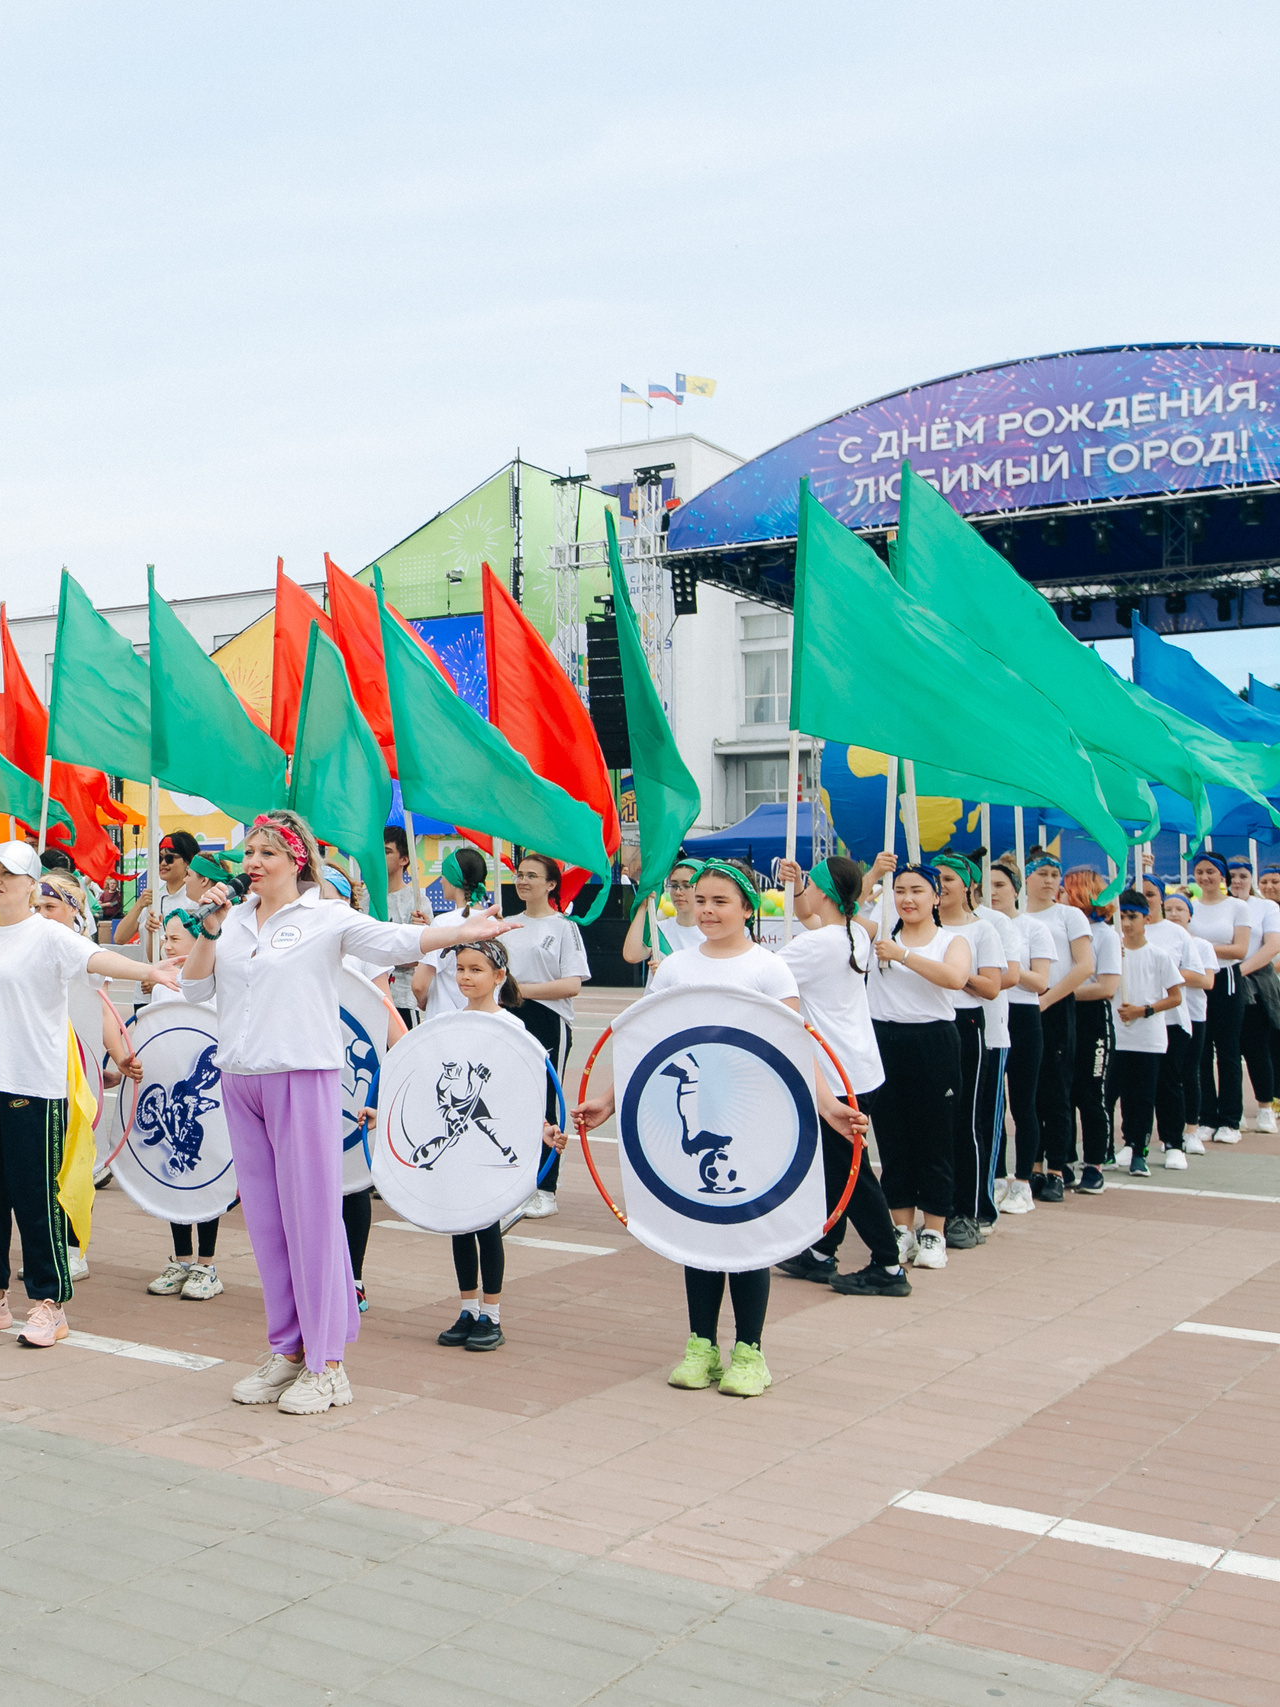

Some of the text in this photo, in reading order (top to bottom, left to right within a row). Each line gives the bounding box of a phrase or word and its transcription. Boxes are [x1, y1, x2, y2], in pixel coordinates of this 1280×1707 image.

[838, 380, 1269, 464] С ДНЁМ РОЖДЕНИЯ,
[1083, 429, 1249, 478] ГОРОД!
